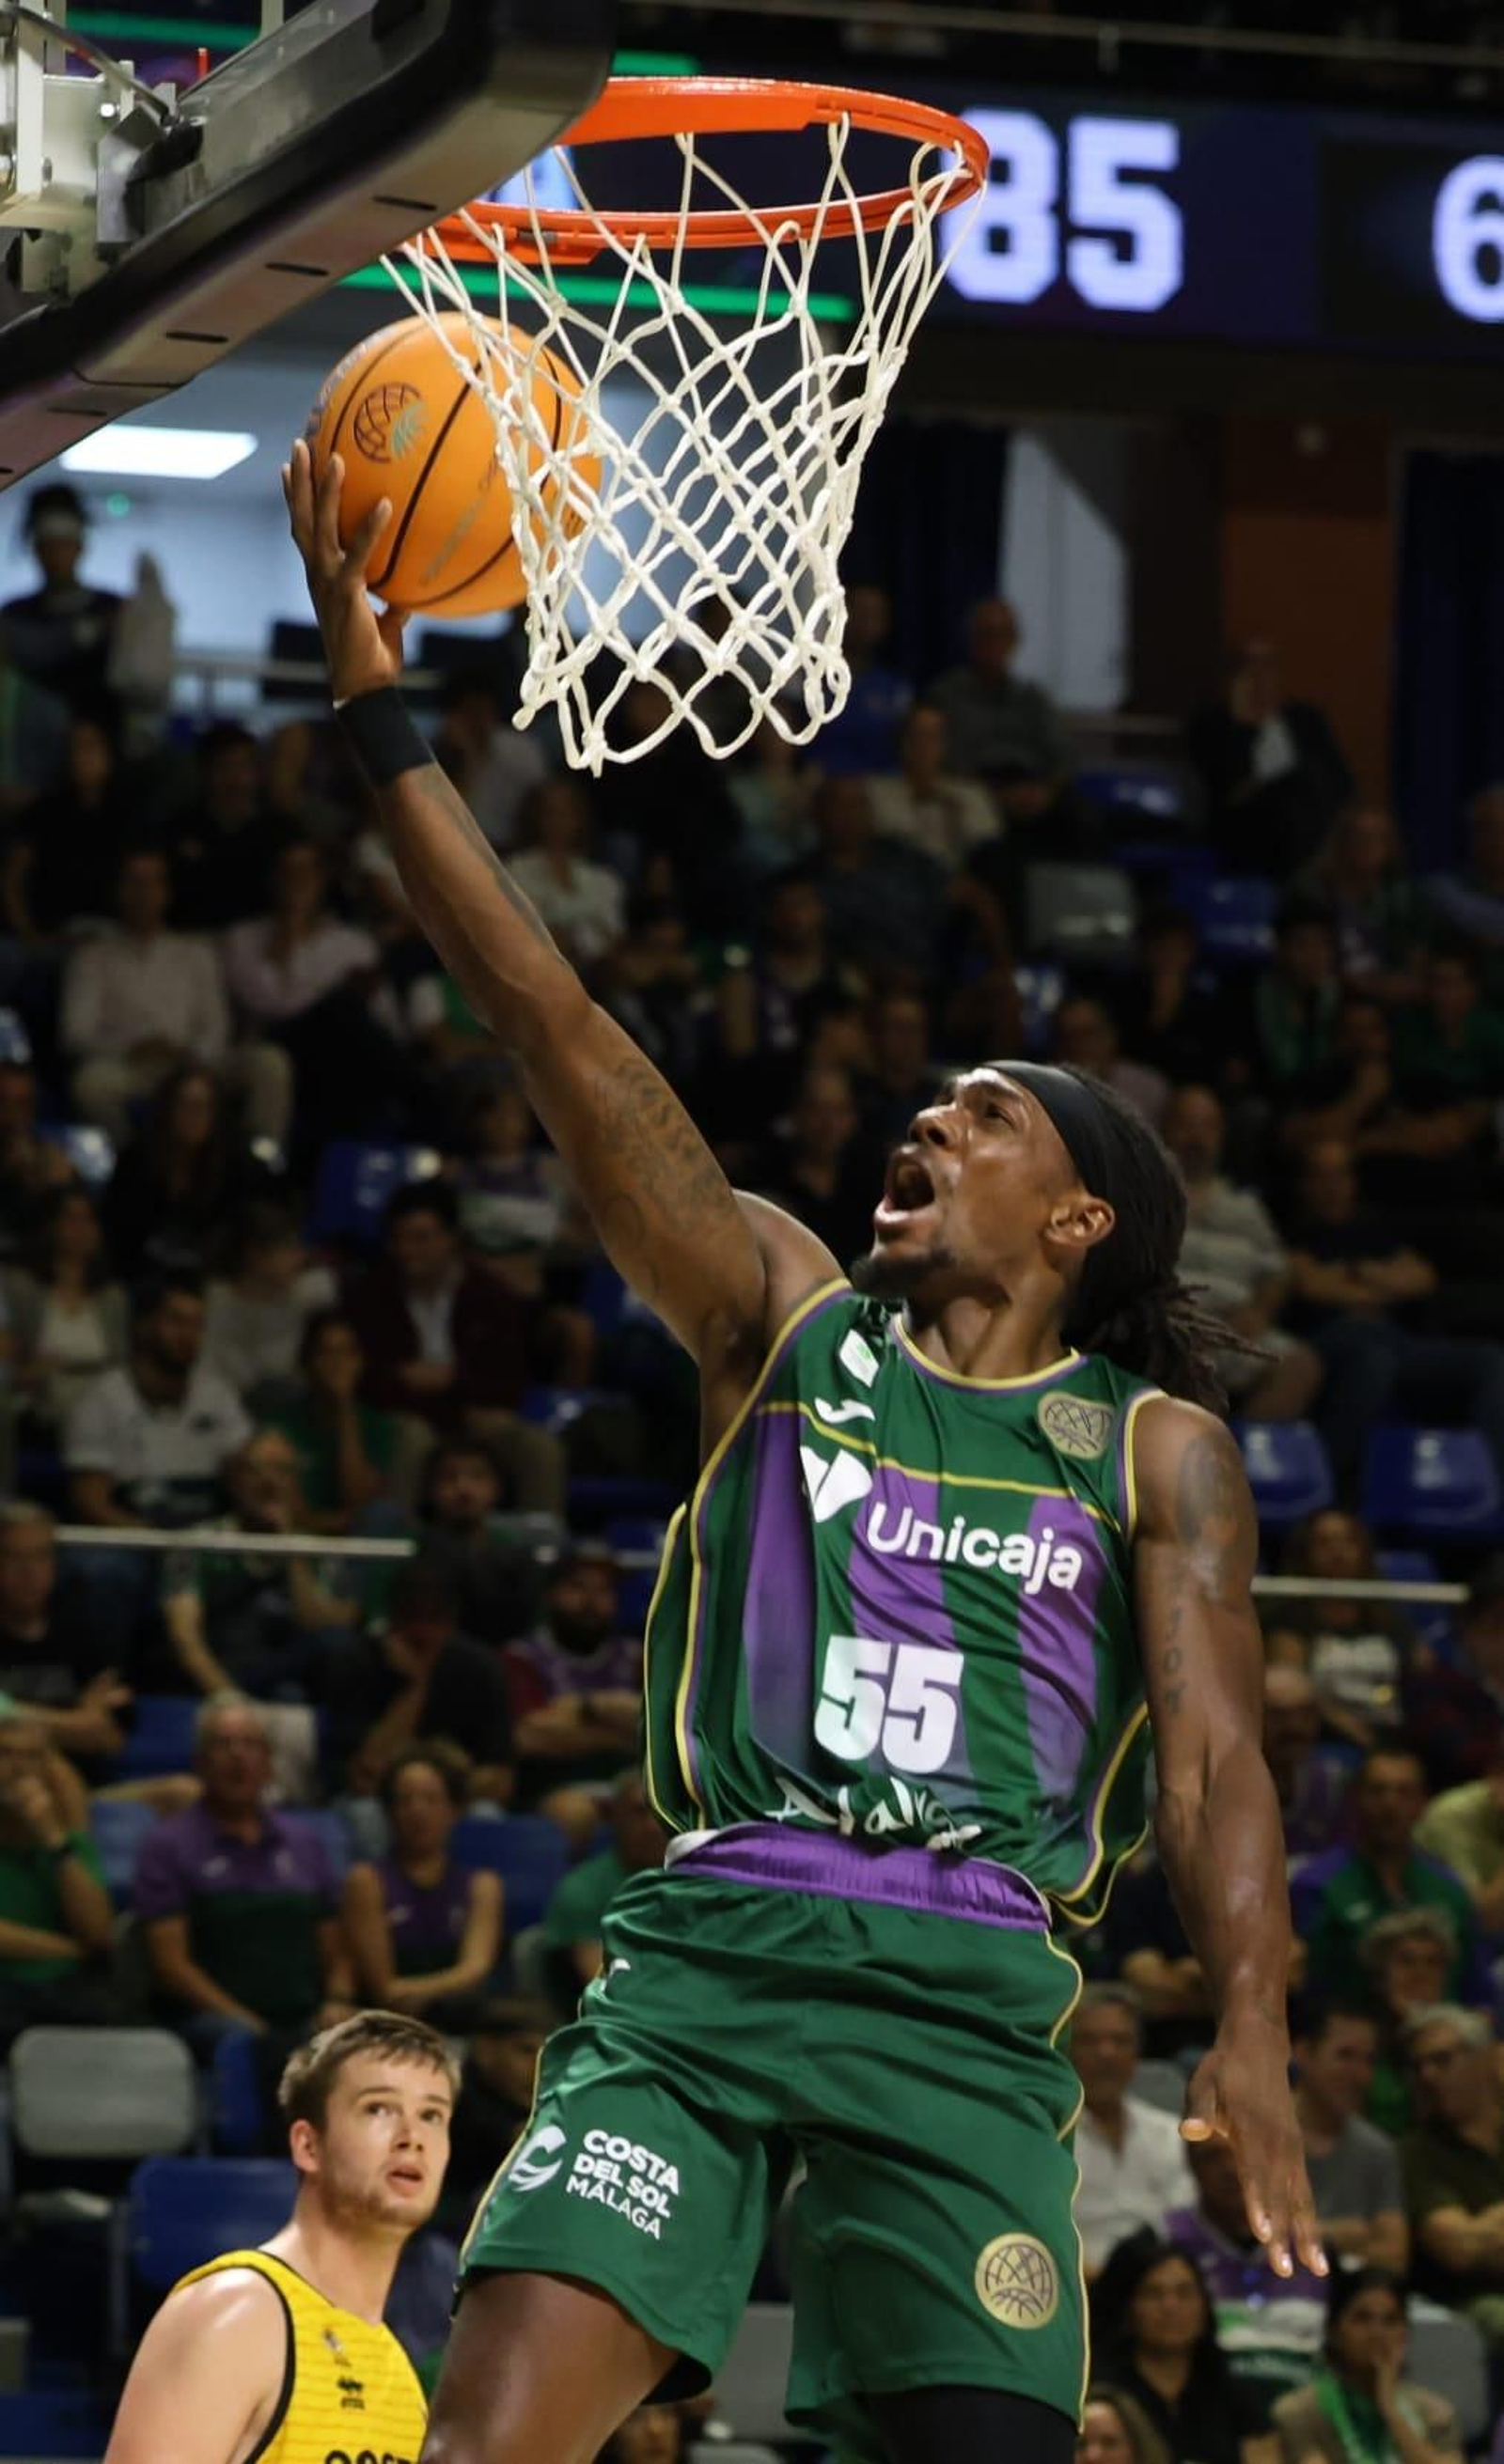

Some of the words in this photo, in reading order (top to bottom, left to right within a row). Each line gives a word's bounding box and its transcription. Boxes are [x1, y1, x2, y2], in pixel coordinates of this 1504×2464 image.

[939, 107, 1183, 312] 85
[867, 1502, 1082, 1595] Unicaja
[814, 1634, 964, 1774] 55
[572, 2152, 624, 2189] DEL
[625, 2175, 671, 2219] SOL
[583, 2129, 679, 2196] COSTA
[566, 2174, 661, 2240] MÁLAGA
